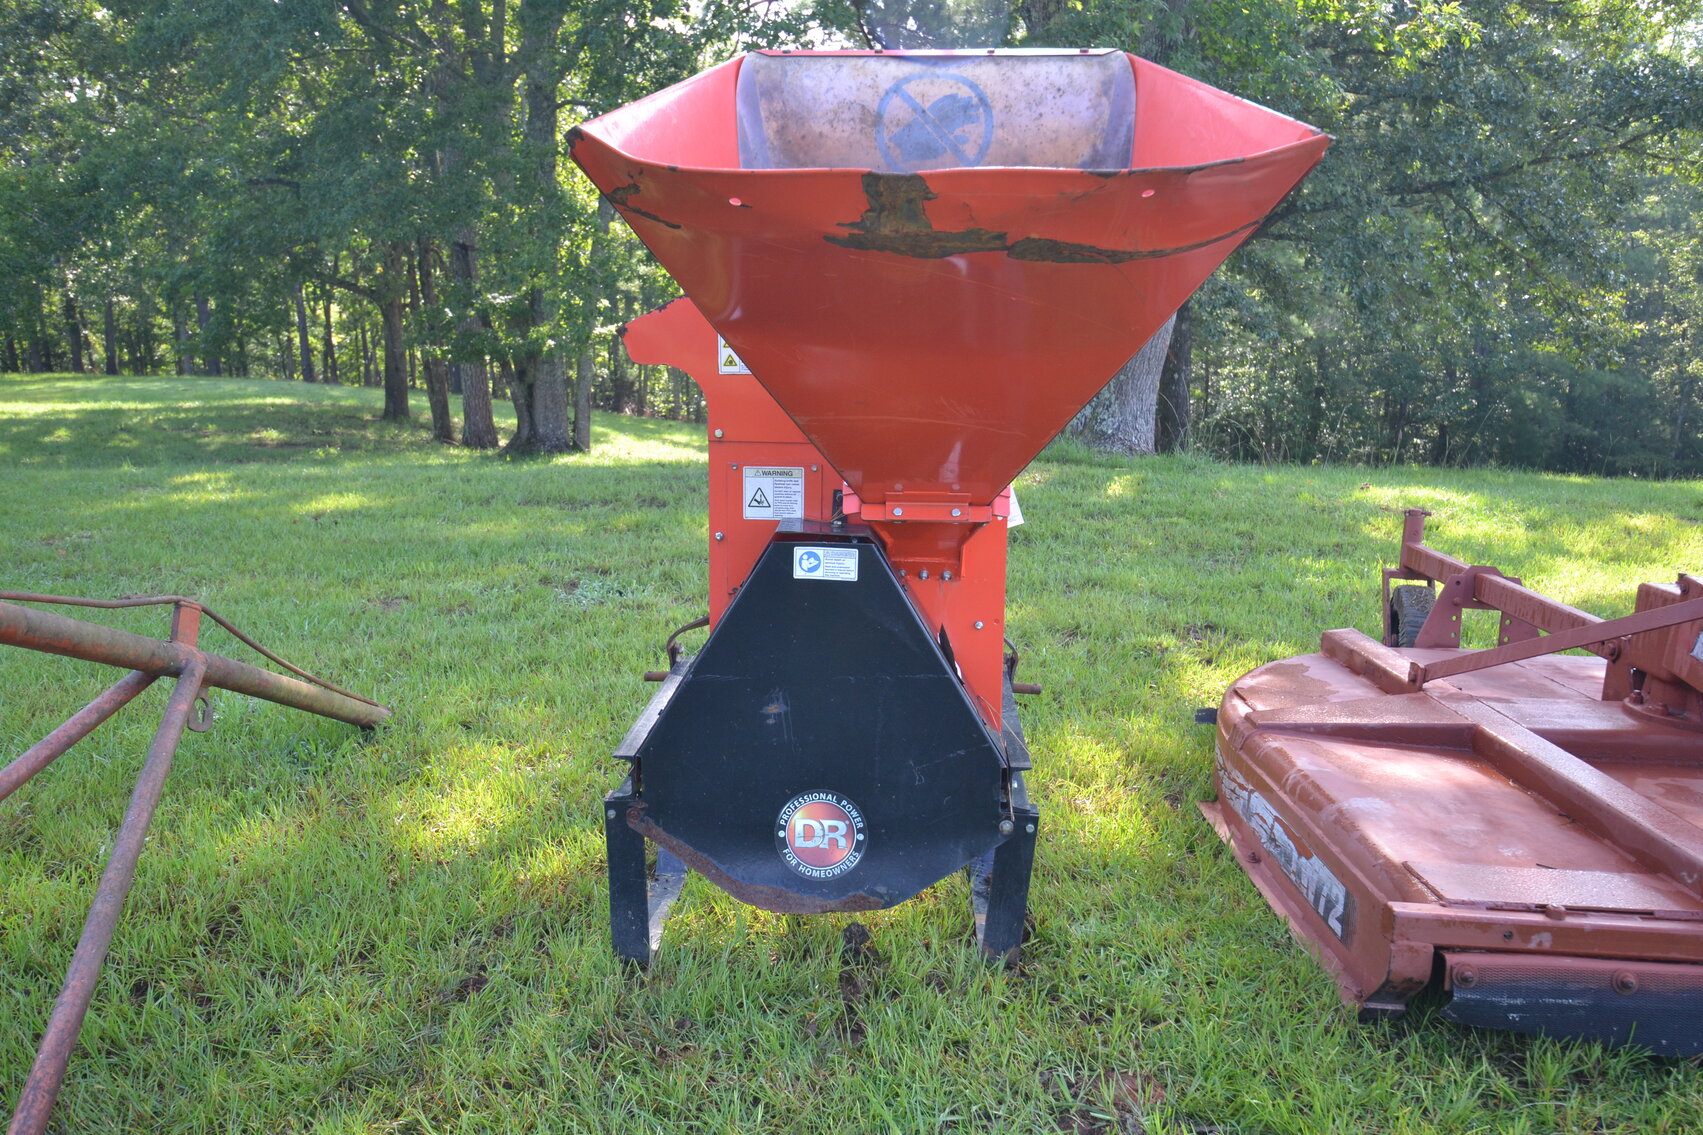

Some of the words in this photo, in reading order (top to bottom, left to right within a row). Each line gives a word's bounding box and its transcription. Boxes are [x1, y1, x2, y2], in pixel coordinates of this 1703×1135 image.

[780, 792, 837, 825] PROFESSIONAL
[840, 800, 863, 829] POWER
[794, 818, 848, 849] DR
[782, 848, 798, 866] FOR
[798, 850, 859, 878] HOMEOWNERS
